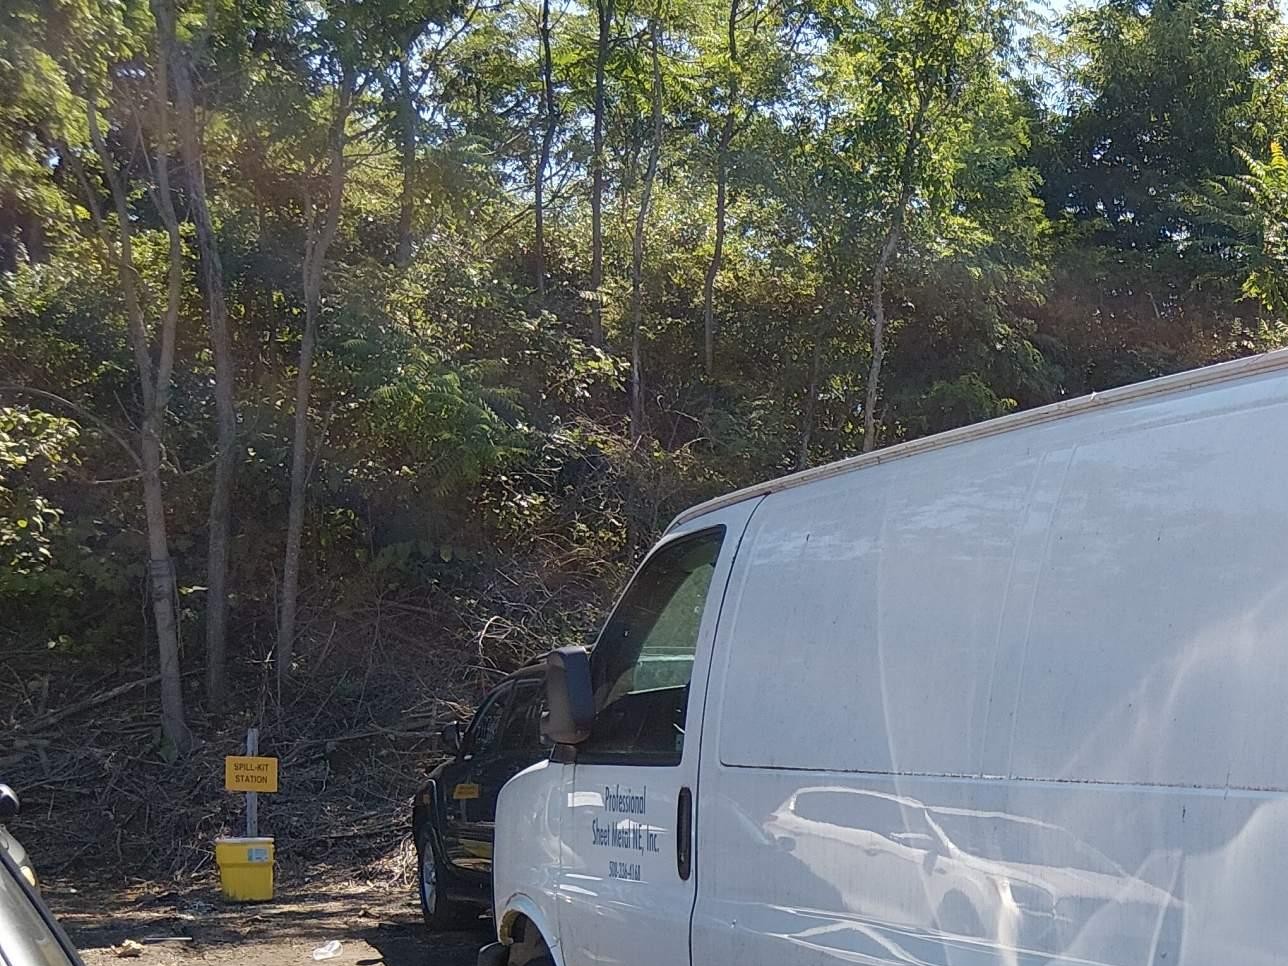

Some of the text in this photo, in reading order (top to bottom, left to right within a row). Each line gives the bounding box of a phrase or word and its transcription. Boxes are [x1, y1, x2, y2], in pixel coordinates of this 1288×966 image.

[234, 763, 268, 771] SPILL-KIT
[235, 774, 268, 784] STATION
[604, 783, 647, 815] Professional
[592, 817, 610, 846] Sheet
[612, 818, 631, 849] Metal
[647, 825, 660, 853] Inc.
